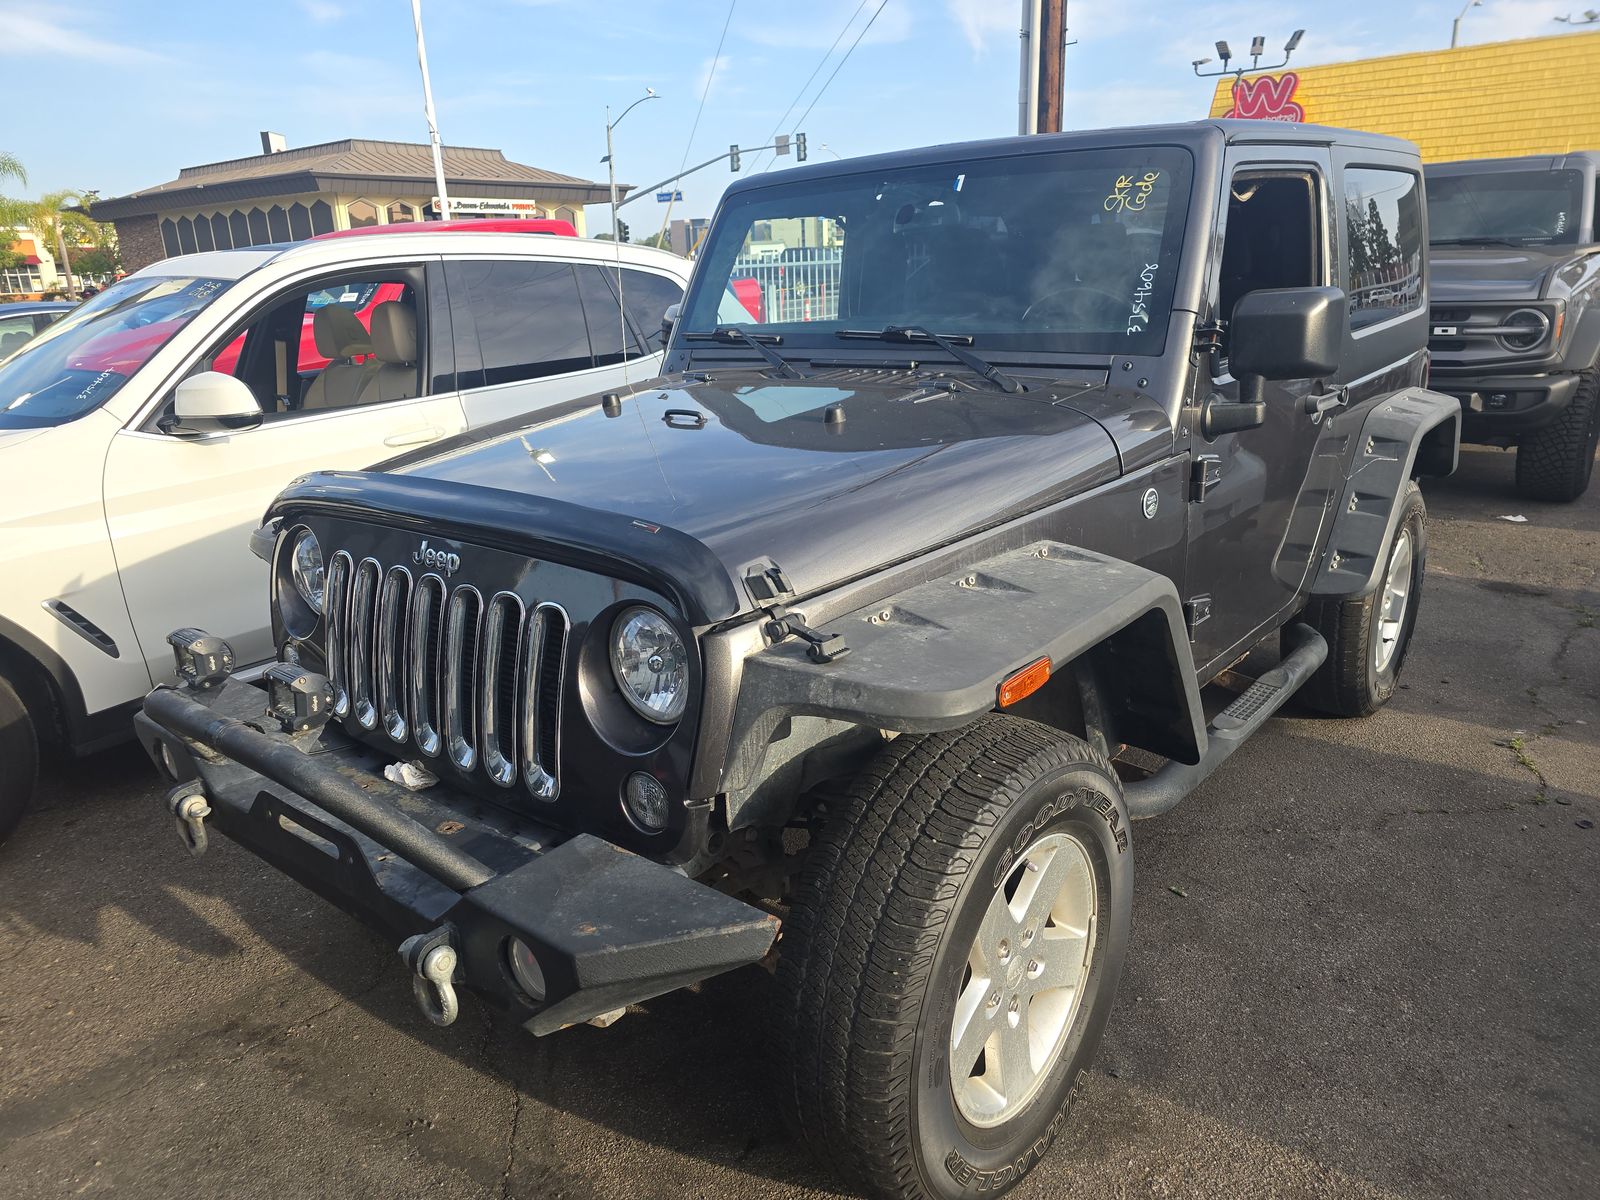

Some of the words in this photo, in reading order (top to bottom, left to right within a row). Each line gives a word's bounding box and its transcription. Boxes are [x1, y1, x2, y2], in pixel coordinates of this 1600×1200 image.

[1126, 263, 1159, 336] 3754608
[412, 540, 461, 578] Jeep
[992, 785, 1129, 889] GOODYEAR
[944, 1067, 1088, 1191] WRANGLER
